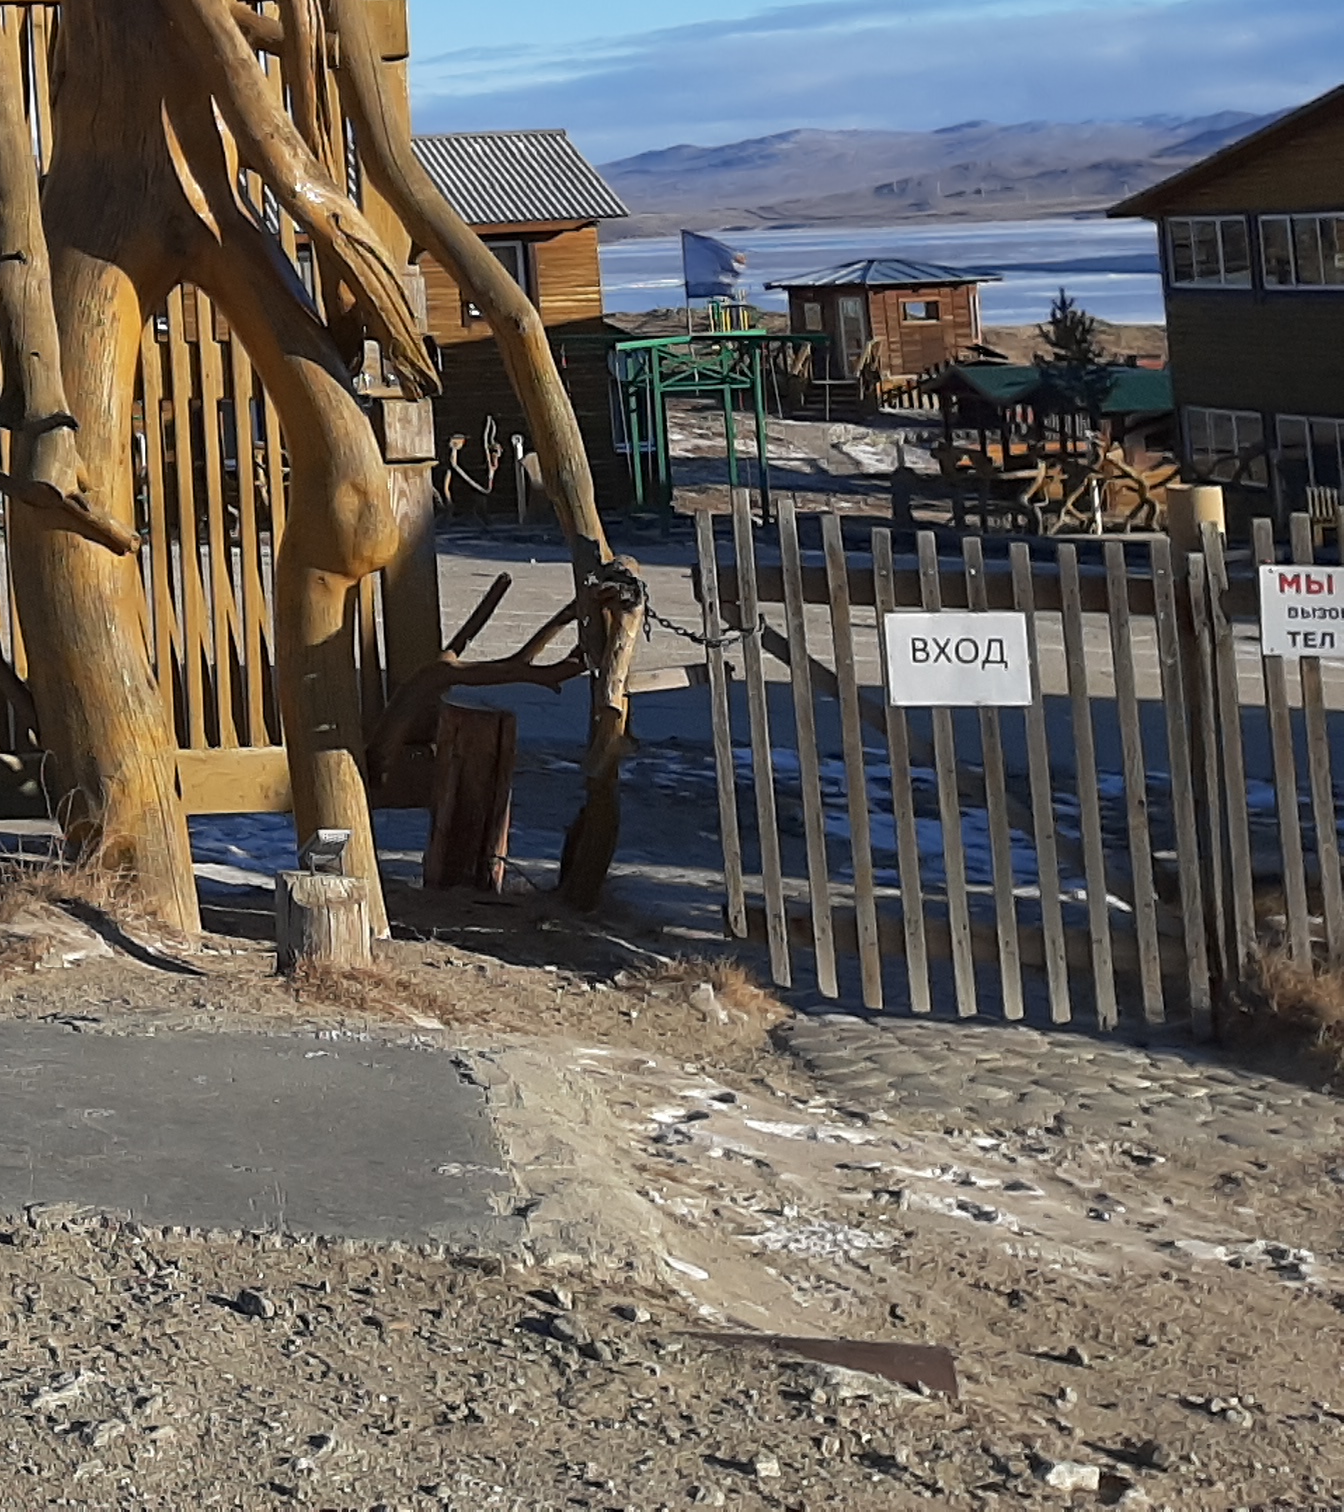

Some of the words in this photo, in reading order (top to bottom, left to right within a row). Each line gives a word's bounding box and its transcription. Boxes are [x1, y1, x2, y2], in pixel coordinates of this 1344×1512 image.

[1278, 572, 1334, 595] МЫ
[1286, 630, 1336, 649] ТЕЛ
[911, 637, 1009, 671] ВХОД
